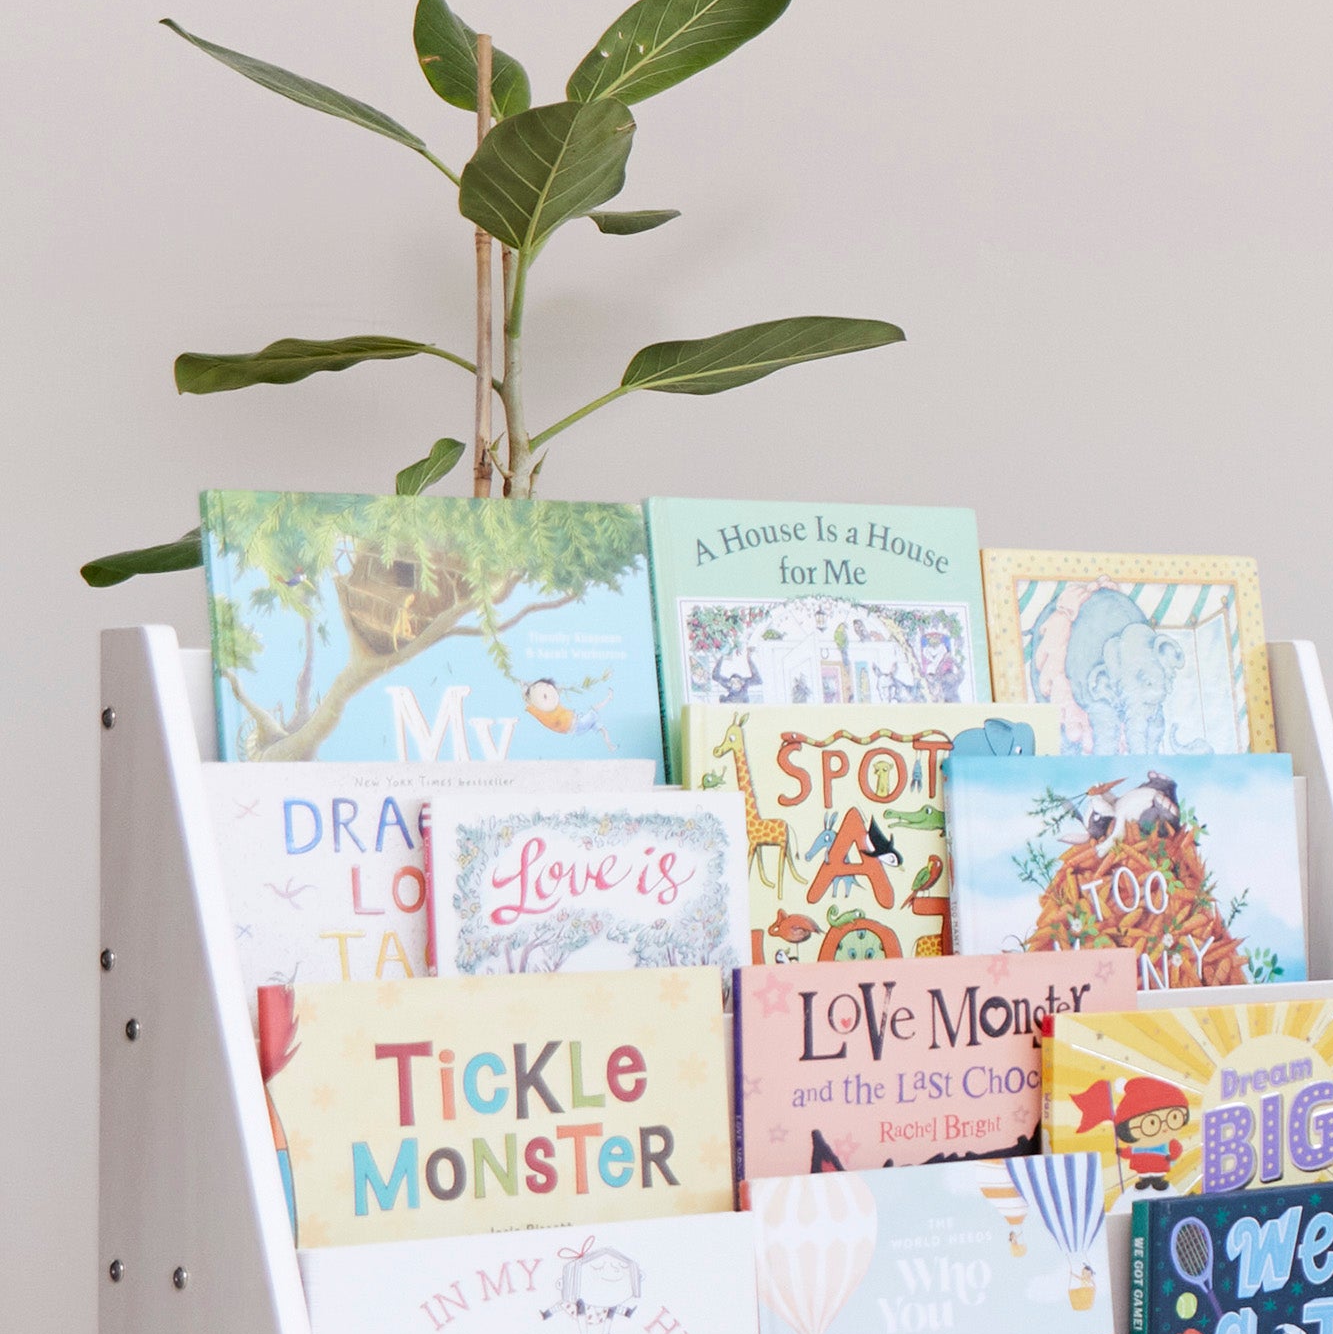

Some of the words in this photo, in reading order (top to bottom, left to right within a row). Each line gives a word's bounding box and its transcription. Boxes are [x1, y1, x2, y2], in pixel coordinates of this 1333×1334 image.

[695, 538, 719, 567] A
[717, 521, 808, 555] House
[814, 515, 838, 543] Is
[845, 526, 859, 547] a
[866, 521, 950, 575] House
[779, 555, 818, 586] for
[822, 558, 868, 586] Me
[777, 740, 955, 809] SPOT
[283, 795, 425, 856] DRA
[489, 837, 633, 926] Love
[636, 846, 696, 905] is
[806, 806, 895, 910] A
[351, 865, 427, 915] LO
[1081, 866, 1169, 922] TOO
[319, 930, 430, 982] TA
[791, 1080, 834, 1109] and
[844, 1073, 887, 1107] the
[961, 1065, 1041, 1101] Choc
[1220, 1056, 1314, 1102] Dream
[878, 1116, 938, 1145] Rachel
[943, 1113, 1003, 1142] Bright
[1134, 1236, 1144, 1259] WE
[419, 1279, 471, 1333] IN
[475, 1257, 543, 1304] MY
[897, 1255, 992, 1306] Who
[1133, 1261, 1143, 1285] GOT
[877, 1297, 955, 1334] You
[1132, 1287, 1144, 1332] GAME!
